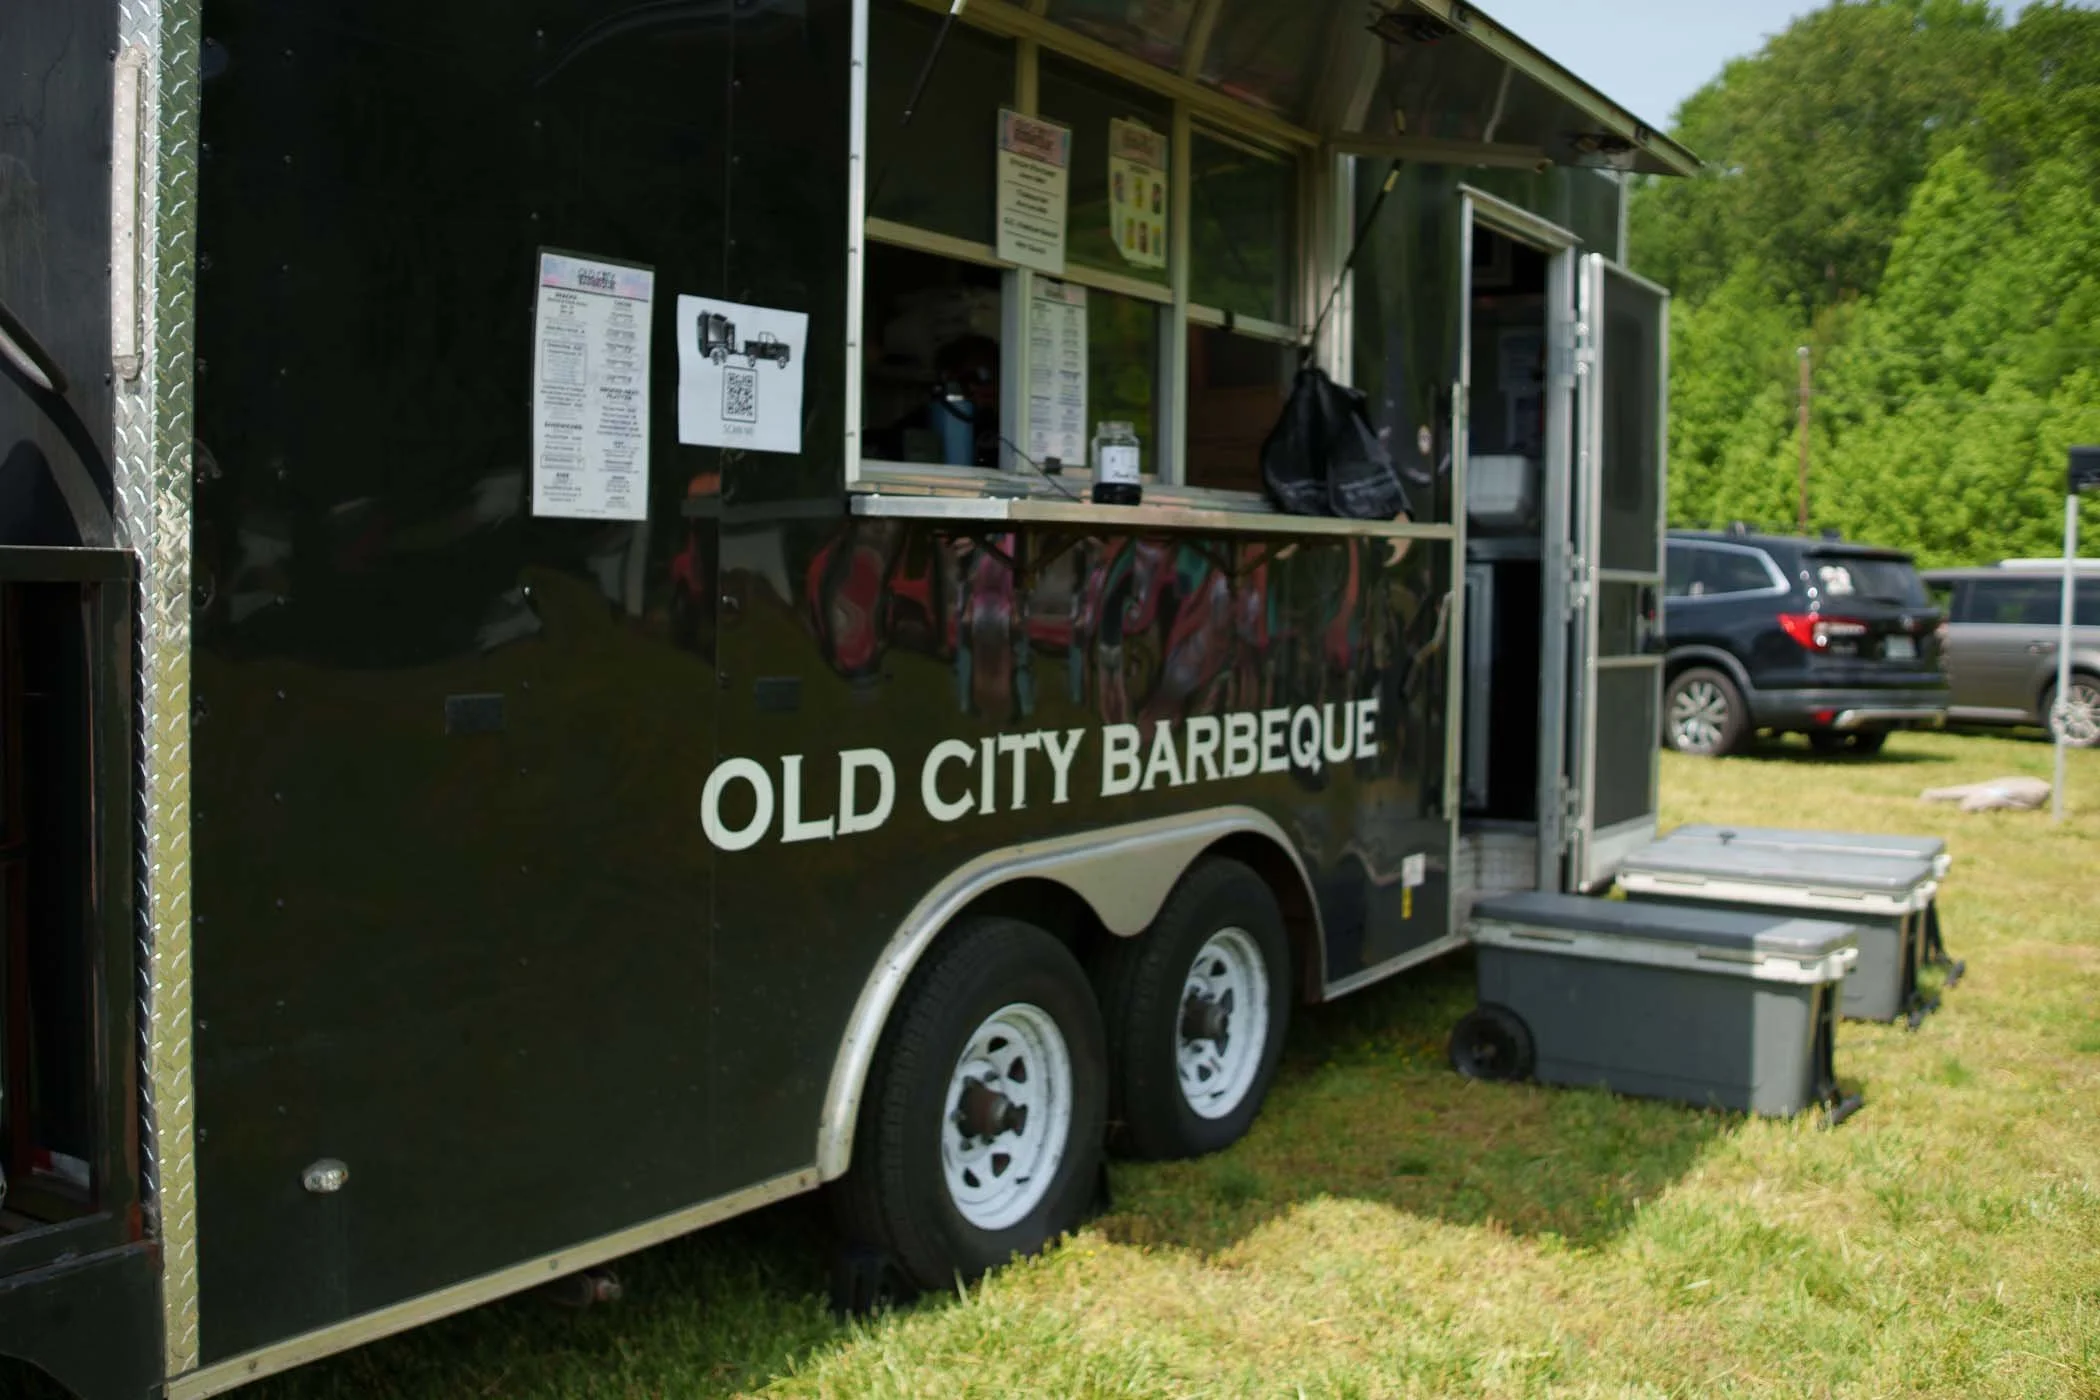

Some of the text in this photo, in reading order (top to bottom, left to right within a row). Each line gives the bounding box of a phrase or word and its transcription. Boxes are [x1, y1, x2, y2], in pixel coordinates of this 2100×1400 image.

[701, 698, 1379, 851] OLD CITY BARBEQUE
